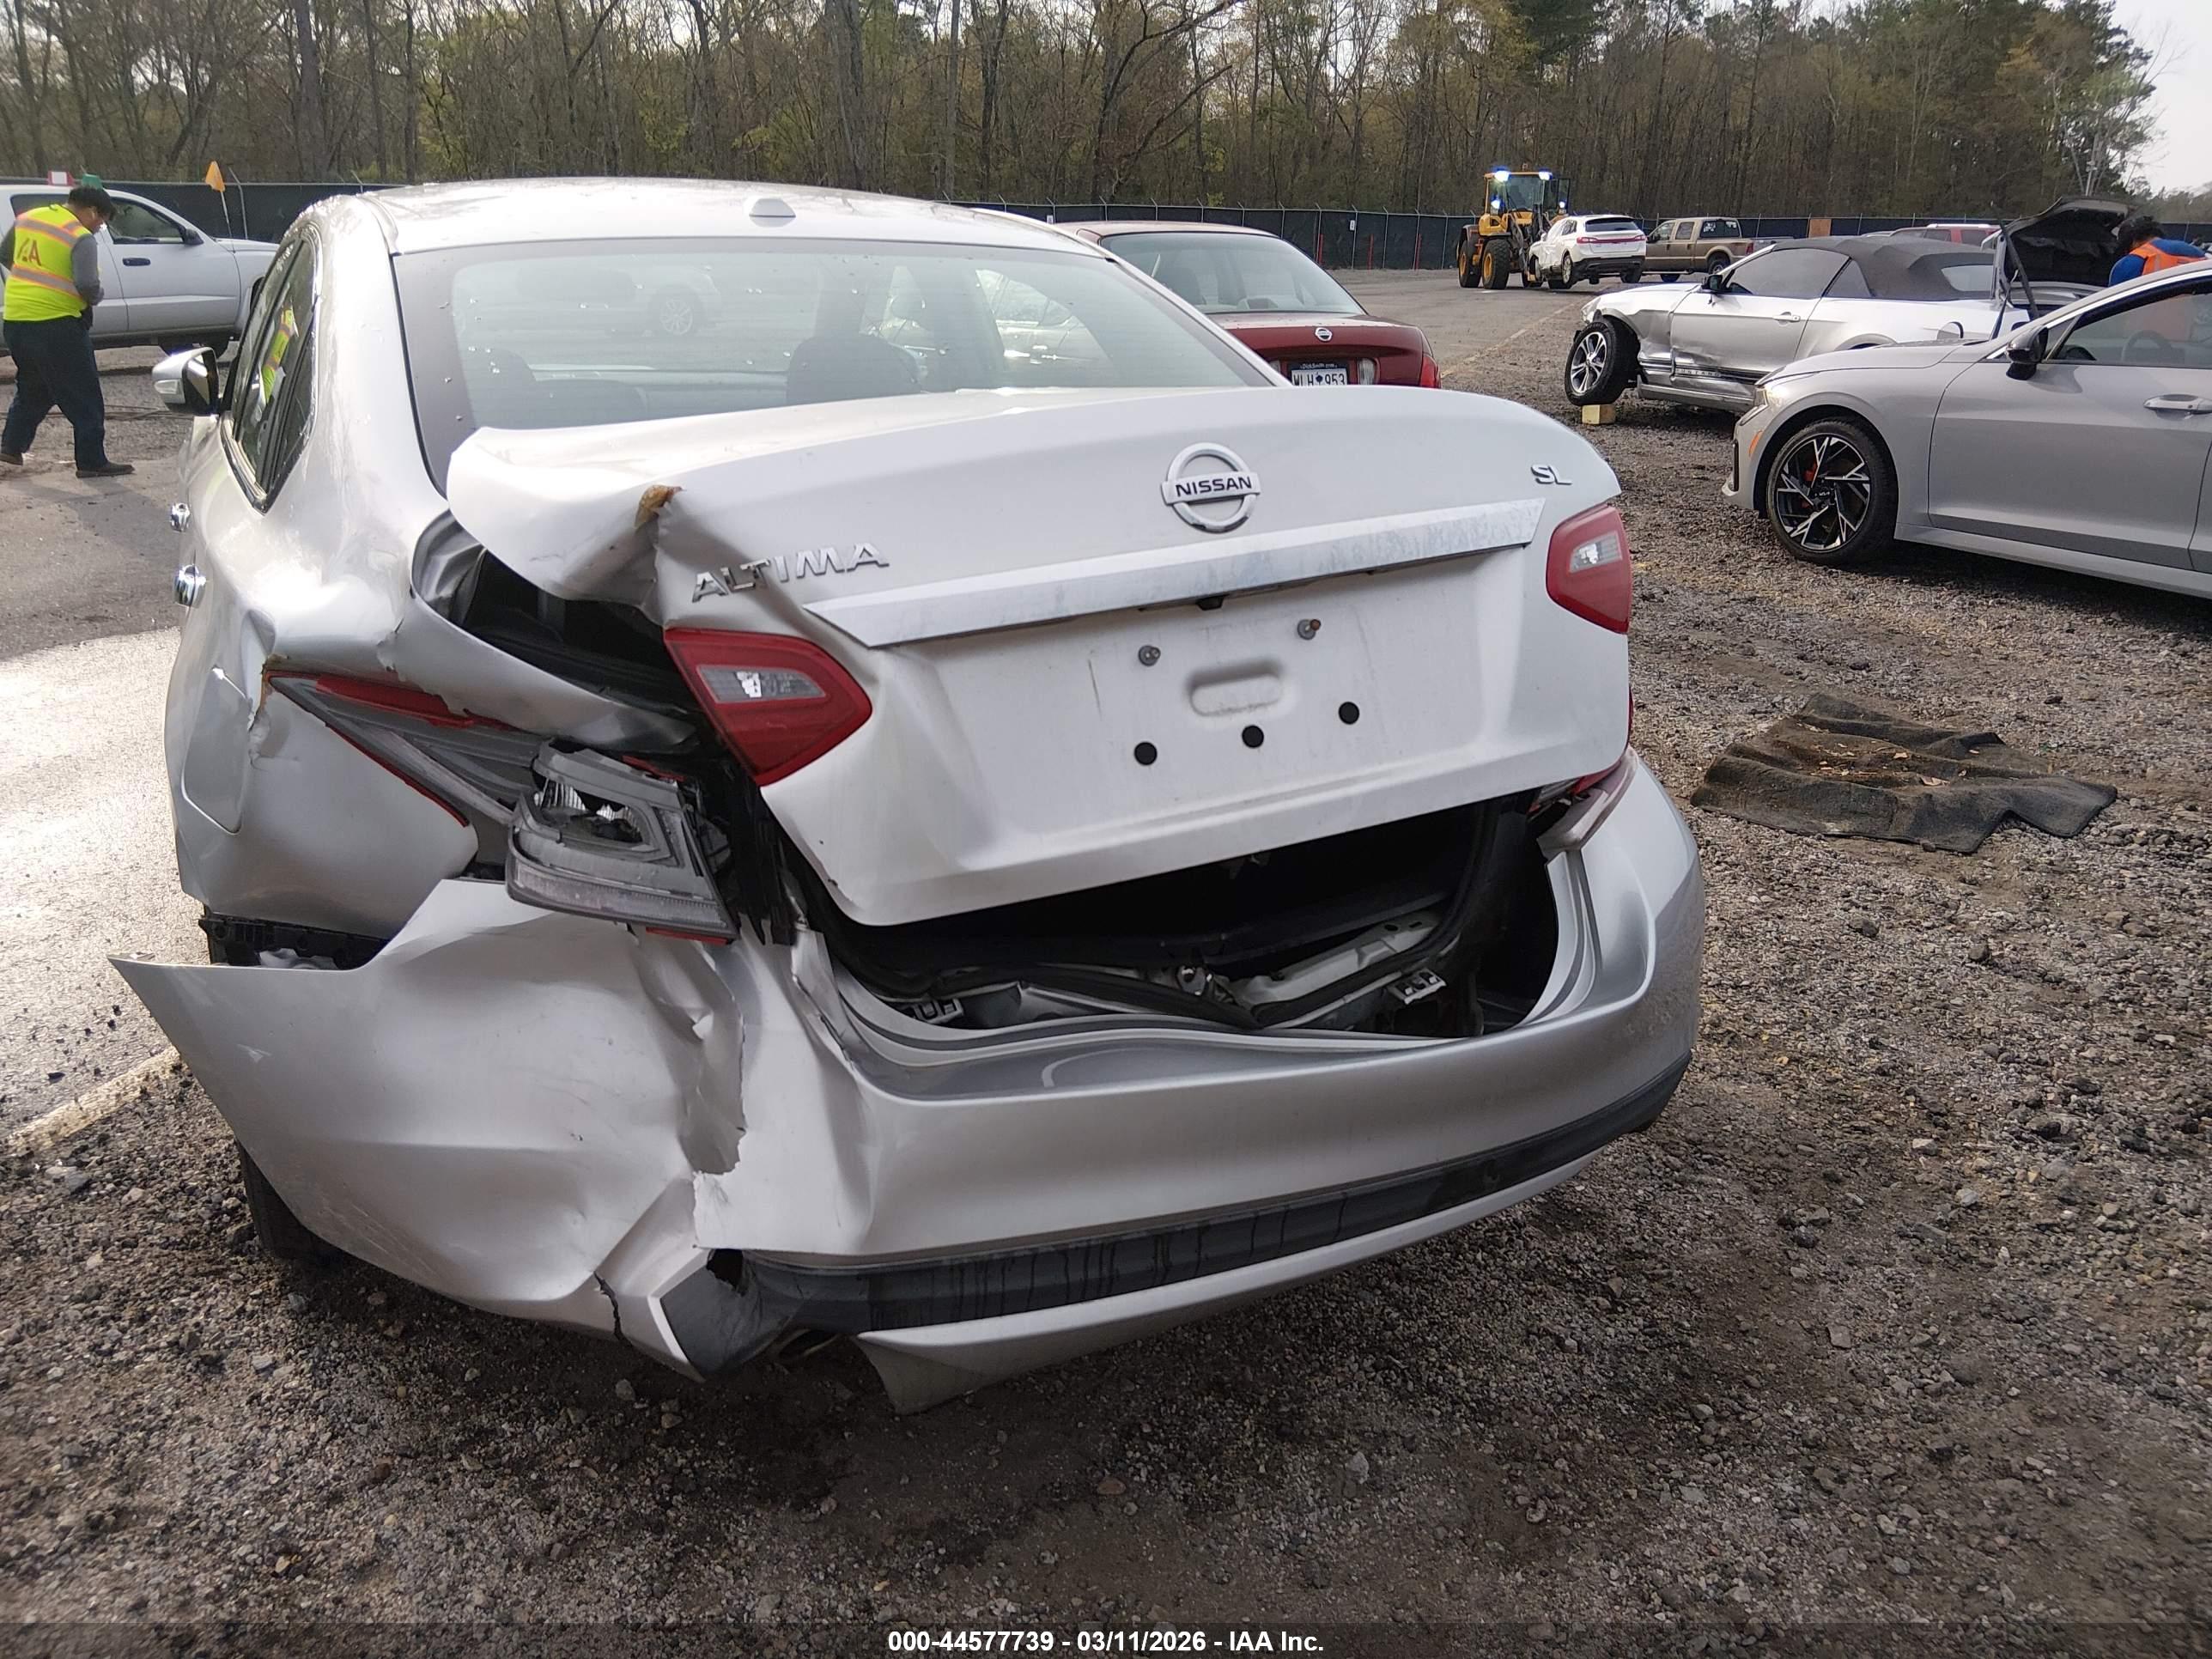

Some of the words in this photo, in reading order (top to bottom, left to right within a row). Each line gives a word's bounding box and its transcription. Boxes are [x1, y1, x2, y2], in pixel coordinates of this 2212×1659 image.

[1529, 464, 1573, 486] SL
[1175, 476, 1252, 498] NISSAN
[691, 542, 890, 604] ALTIMA
